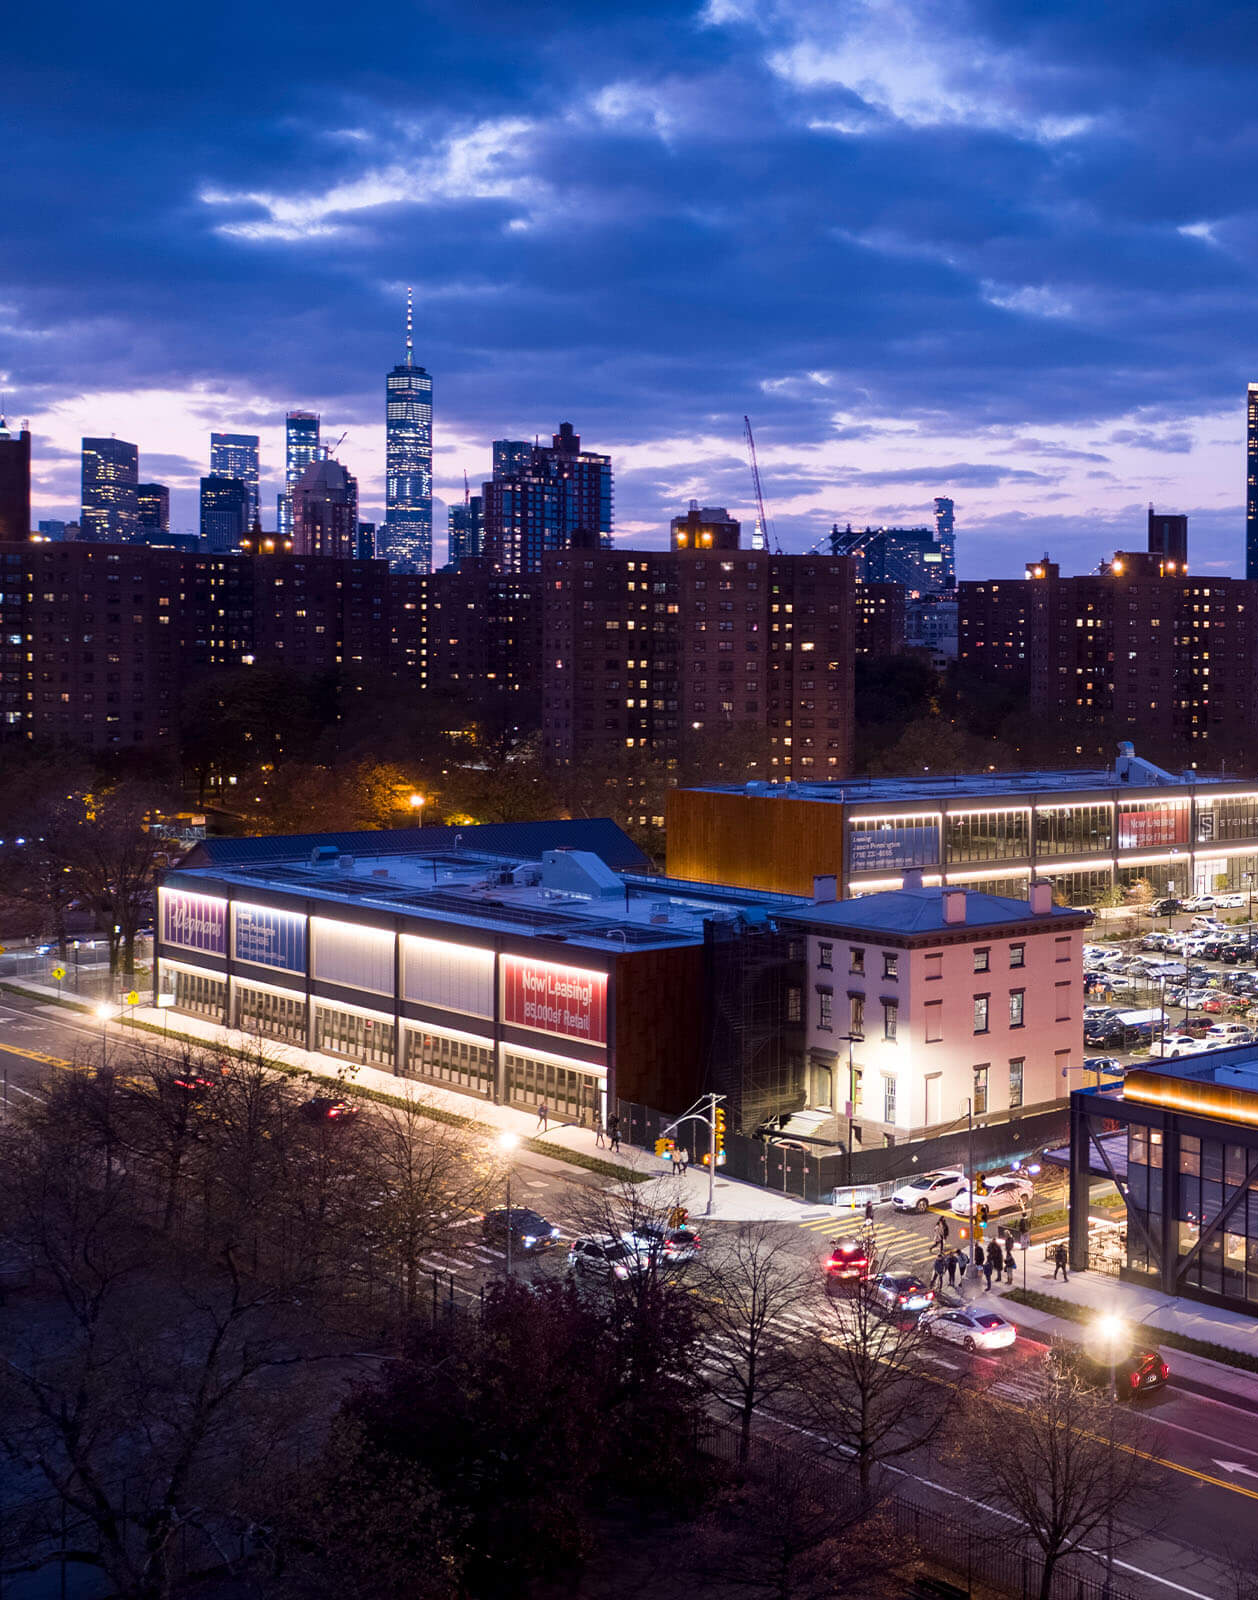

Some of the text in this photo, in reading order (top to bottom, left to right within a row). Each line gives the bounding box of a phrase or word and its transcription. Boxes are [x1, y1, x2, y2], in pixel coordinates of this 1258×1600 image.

[1131, 818, 1146, 828] Now
[1220, 817, 1258, 827] STEINER
[171, 903, 222, 943] Wegmans
[523, 969, 593, 1007] Now Leasing!
[524, 1001, 590, 1031] 85,000sf Retail
